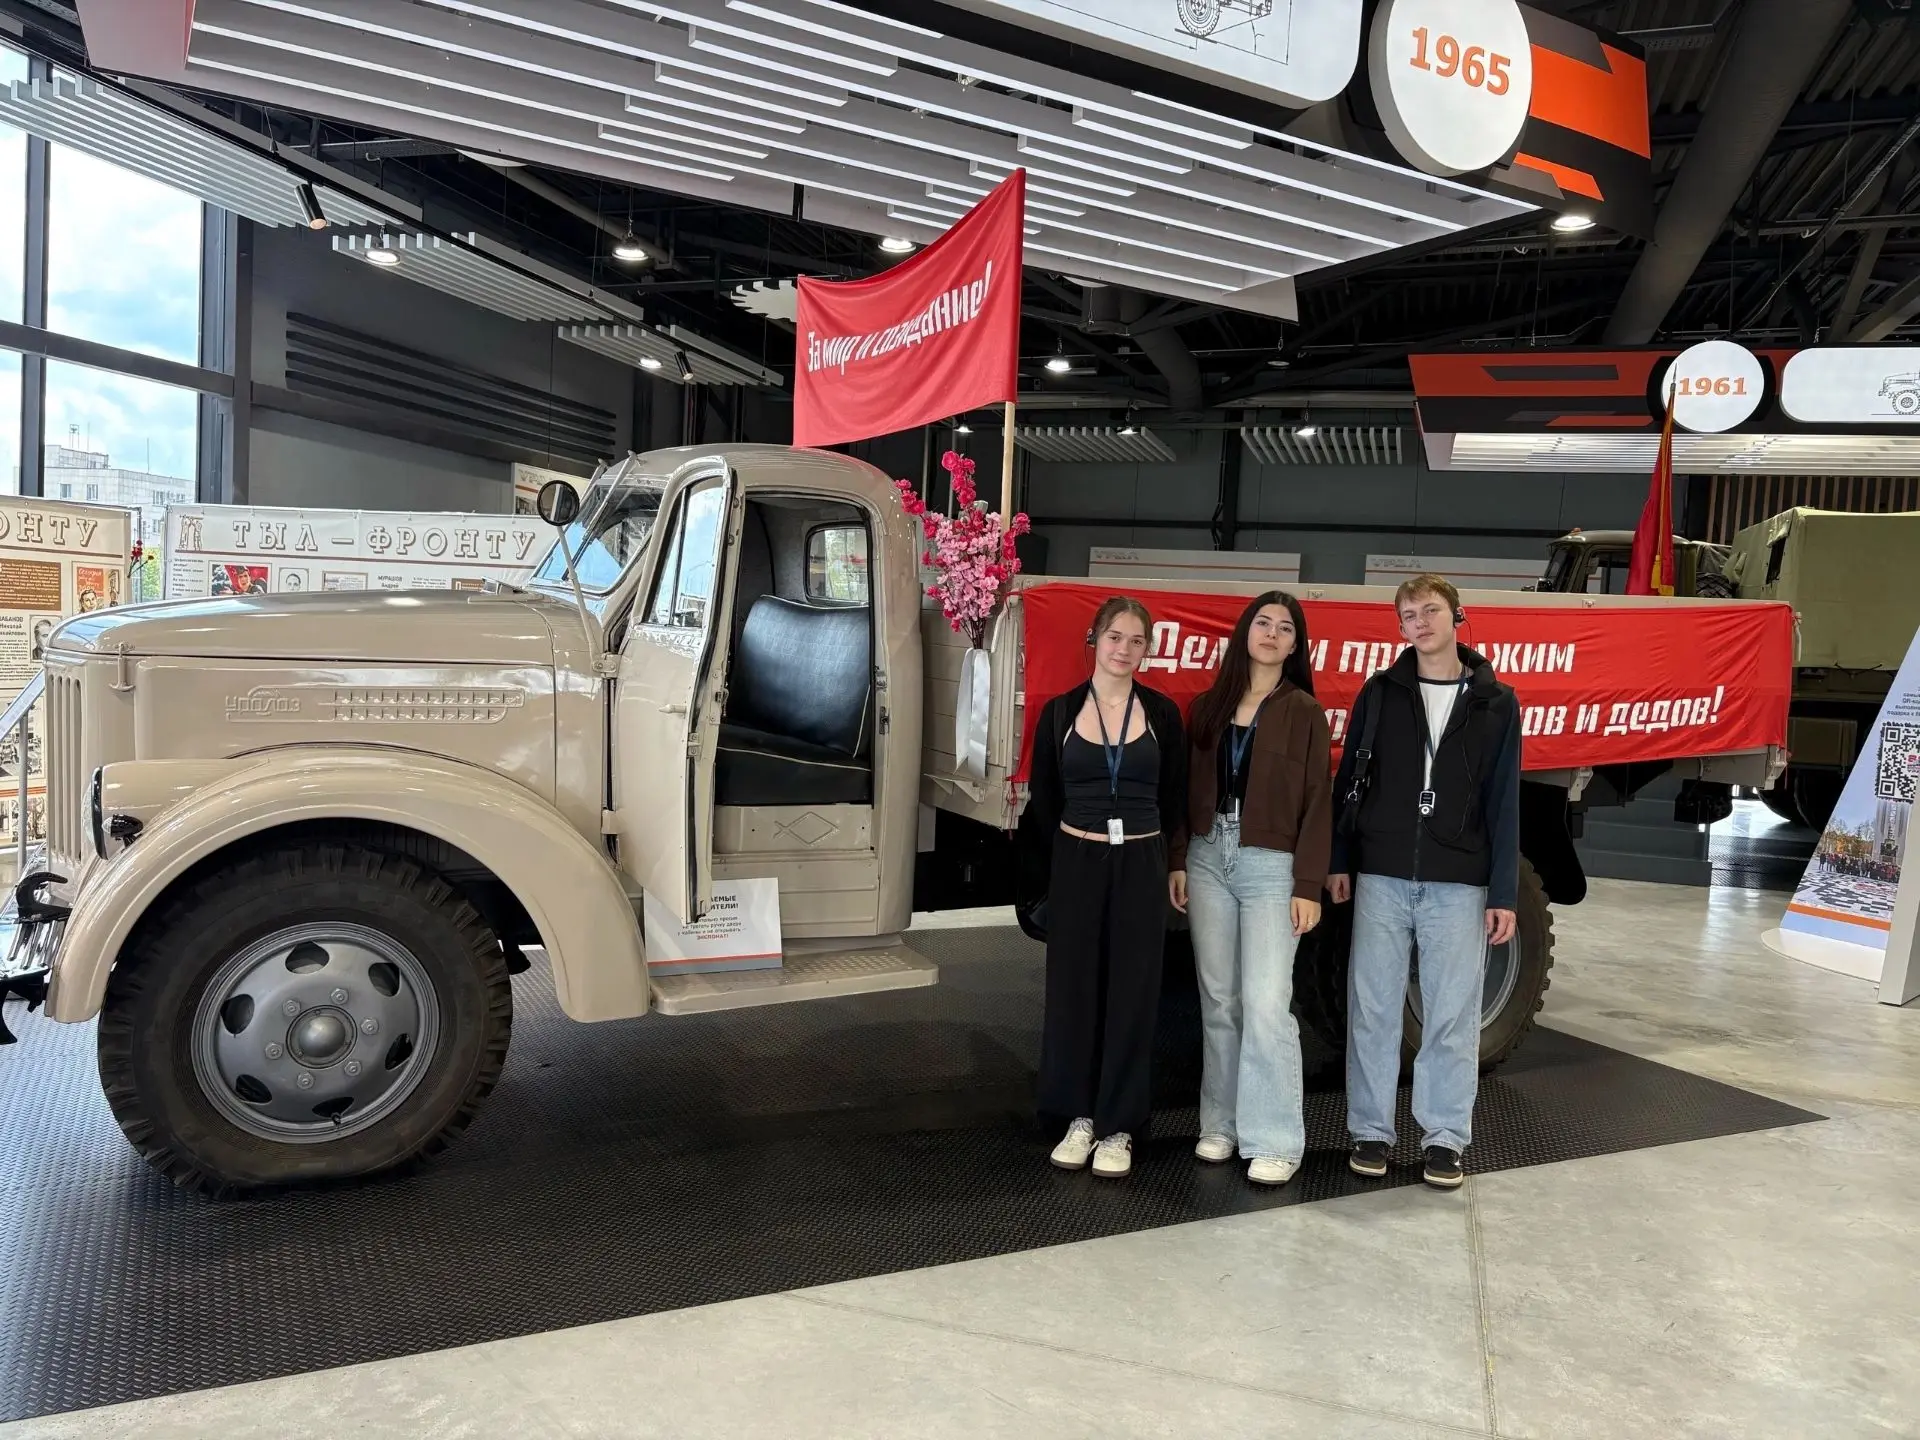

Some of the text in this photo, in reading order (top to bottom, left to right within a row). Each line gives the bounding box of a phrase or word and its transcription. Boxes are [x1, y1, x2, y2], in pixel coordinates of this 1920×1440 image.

[1410, 27, 1510, 95] 1965
[808, 331, 820, 373] За
[823, 335, 863, 376] мир
[1678, 377, 1747, 396] 1961
[233, 521, 318, 552] ТЫЛ
[366, 525, 536, 560] ФРОНТУ
[1574, 703, 1601, 734] и
[1603, 685, 1725, 737] дедов!
